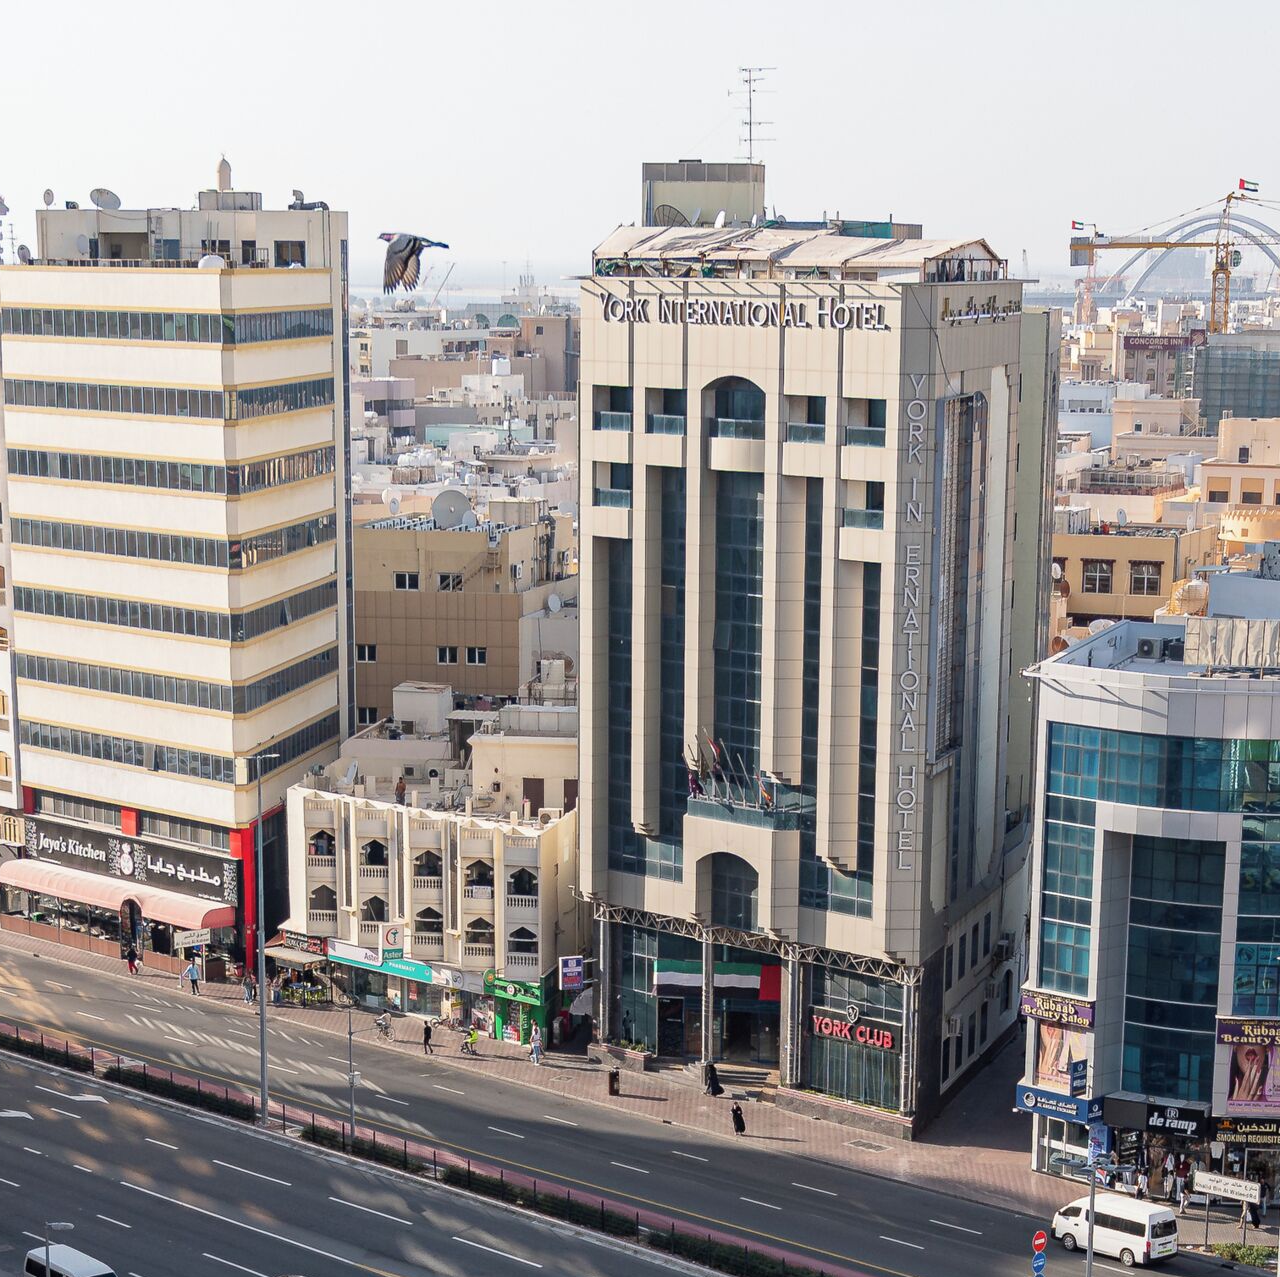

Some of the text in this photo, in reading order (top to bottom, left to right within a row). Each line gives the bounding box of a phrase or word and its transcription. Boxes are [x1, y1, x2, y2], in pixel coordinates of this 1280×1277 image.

[599, 293, 888, 331] YORK INTERNATIONAL HOTEL
[1129, 337, 1169, 345] CONCORDE
[896, 374, 927, 871] YORK HOTEL
[38, 832, 107, 862] Jaya's Kitchen
[176, 862, 221, 887] مطبخ
[383, 951, 402, 959] Aster
[388, 962, 416, 972] PHARMACY
[1020, 1004, 1089, 1027] Beauty Salon
[1034, 997, 1075, 1015] Rübaab
[812, 1015, 892, 1048] YORK CLUB
[1220, 1033, 1271, 1045] Beauty
[1148, 1112, 1197, 1134] de ramp
[1216, 1133, 1247, 1143] SMOKING
[1195, 1182, 1212, 1190] Khalid
